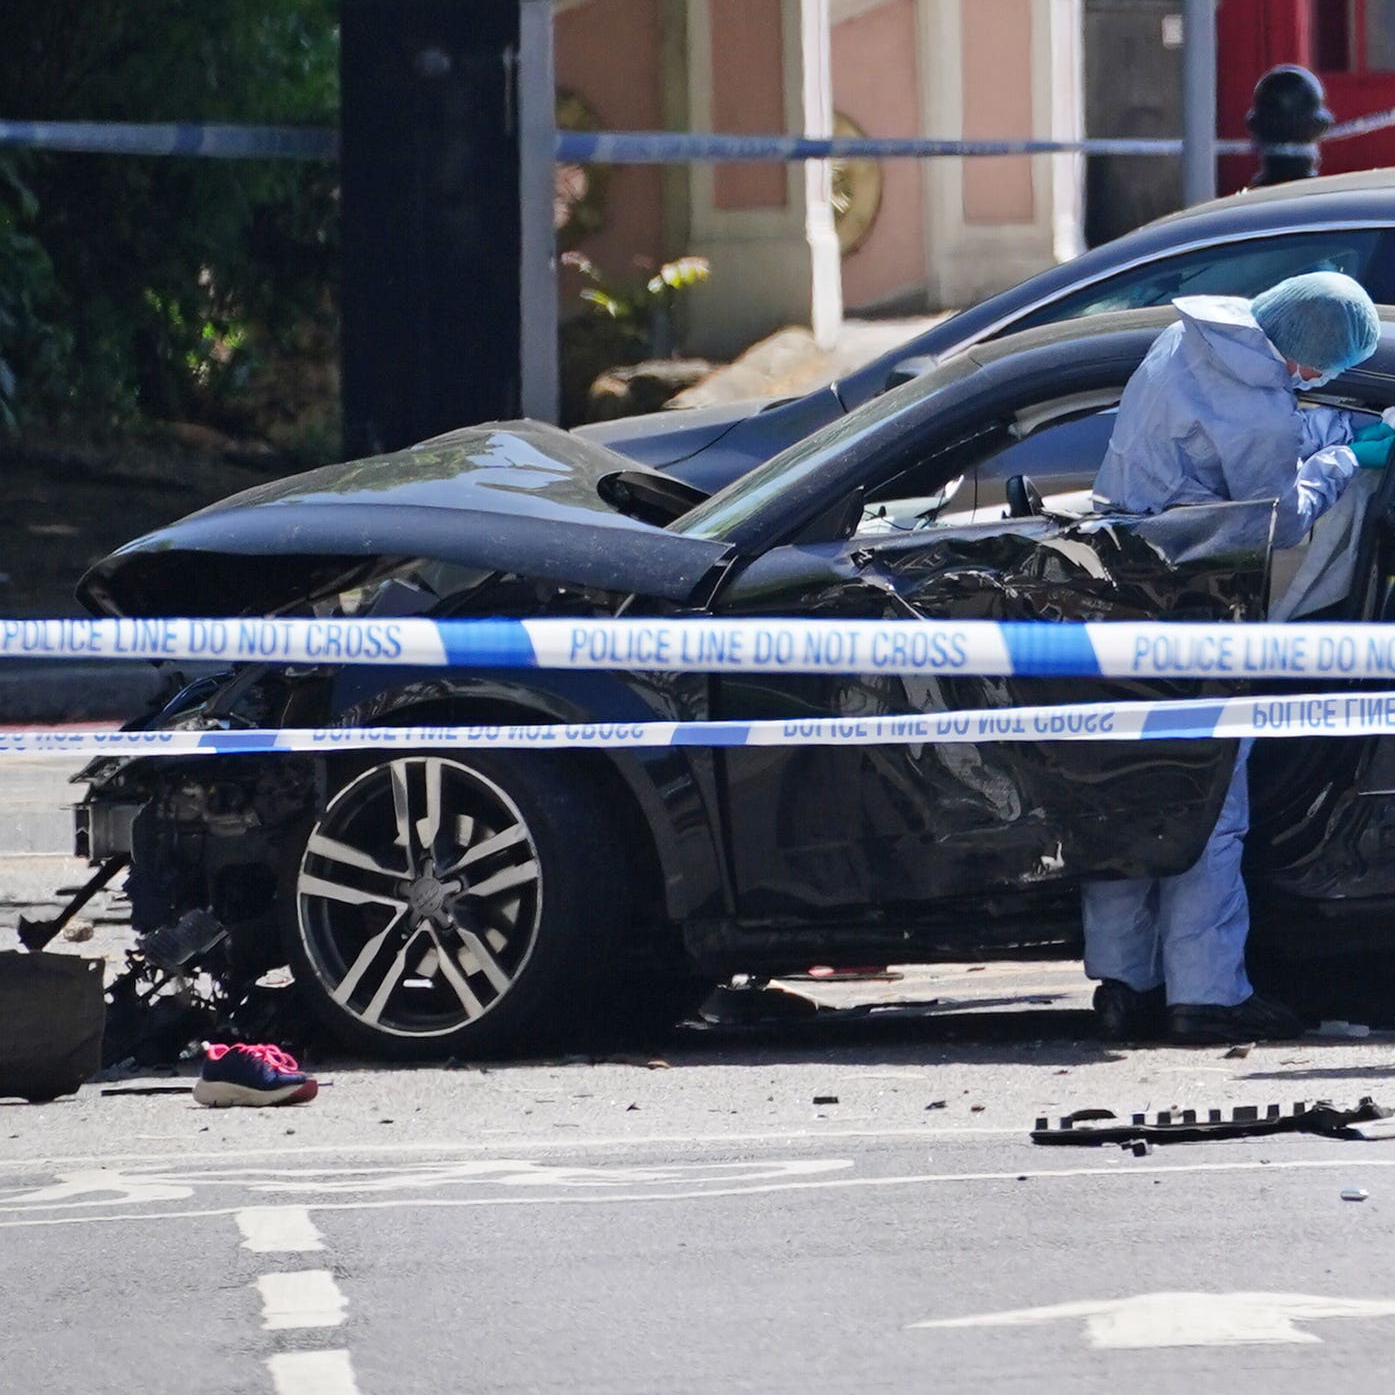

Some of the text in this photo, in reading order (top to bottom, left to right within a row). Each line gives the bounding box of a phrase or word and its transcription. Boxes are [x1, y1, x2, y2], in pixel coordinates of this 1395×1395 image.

[3, 618, 403, 659] POLICE LINE DO NOT CROSS
[570, 629, 967, 668] POLICE LINE DO NOT CROSS
[1133, 634, 1231, 671] POLICE
[1242, 635, 1306, 672] LINE
[1318, 635, 1363, 673] DO
